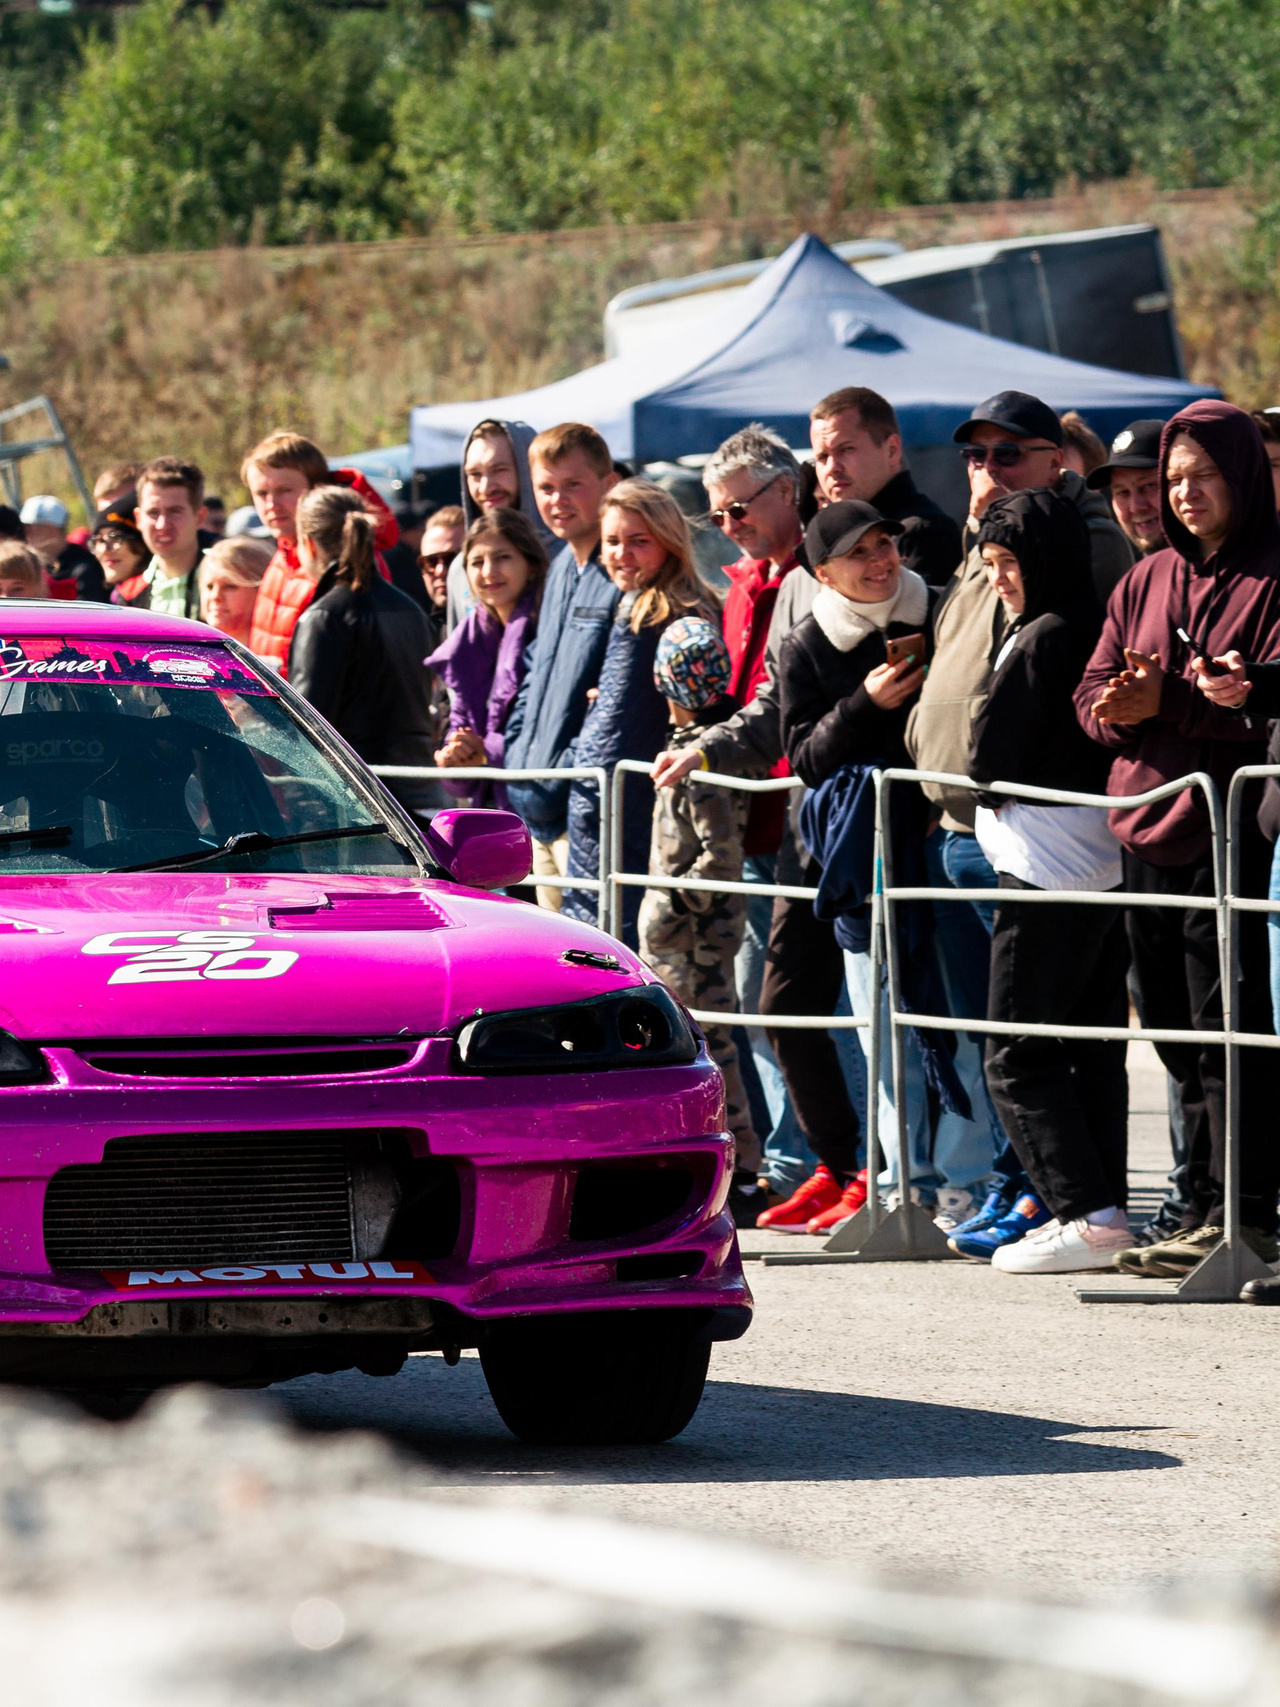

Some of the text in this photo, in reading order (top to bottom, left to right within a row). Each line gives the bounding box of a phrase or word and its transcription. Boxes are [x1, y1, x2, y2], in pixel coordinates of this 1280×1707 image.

[6, 740, 105, 766] sparco
[81, 930, 270, 955] CS
[107, 950, 300, 985] 20
[128, 1261, 414, 1286] MOTUL
